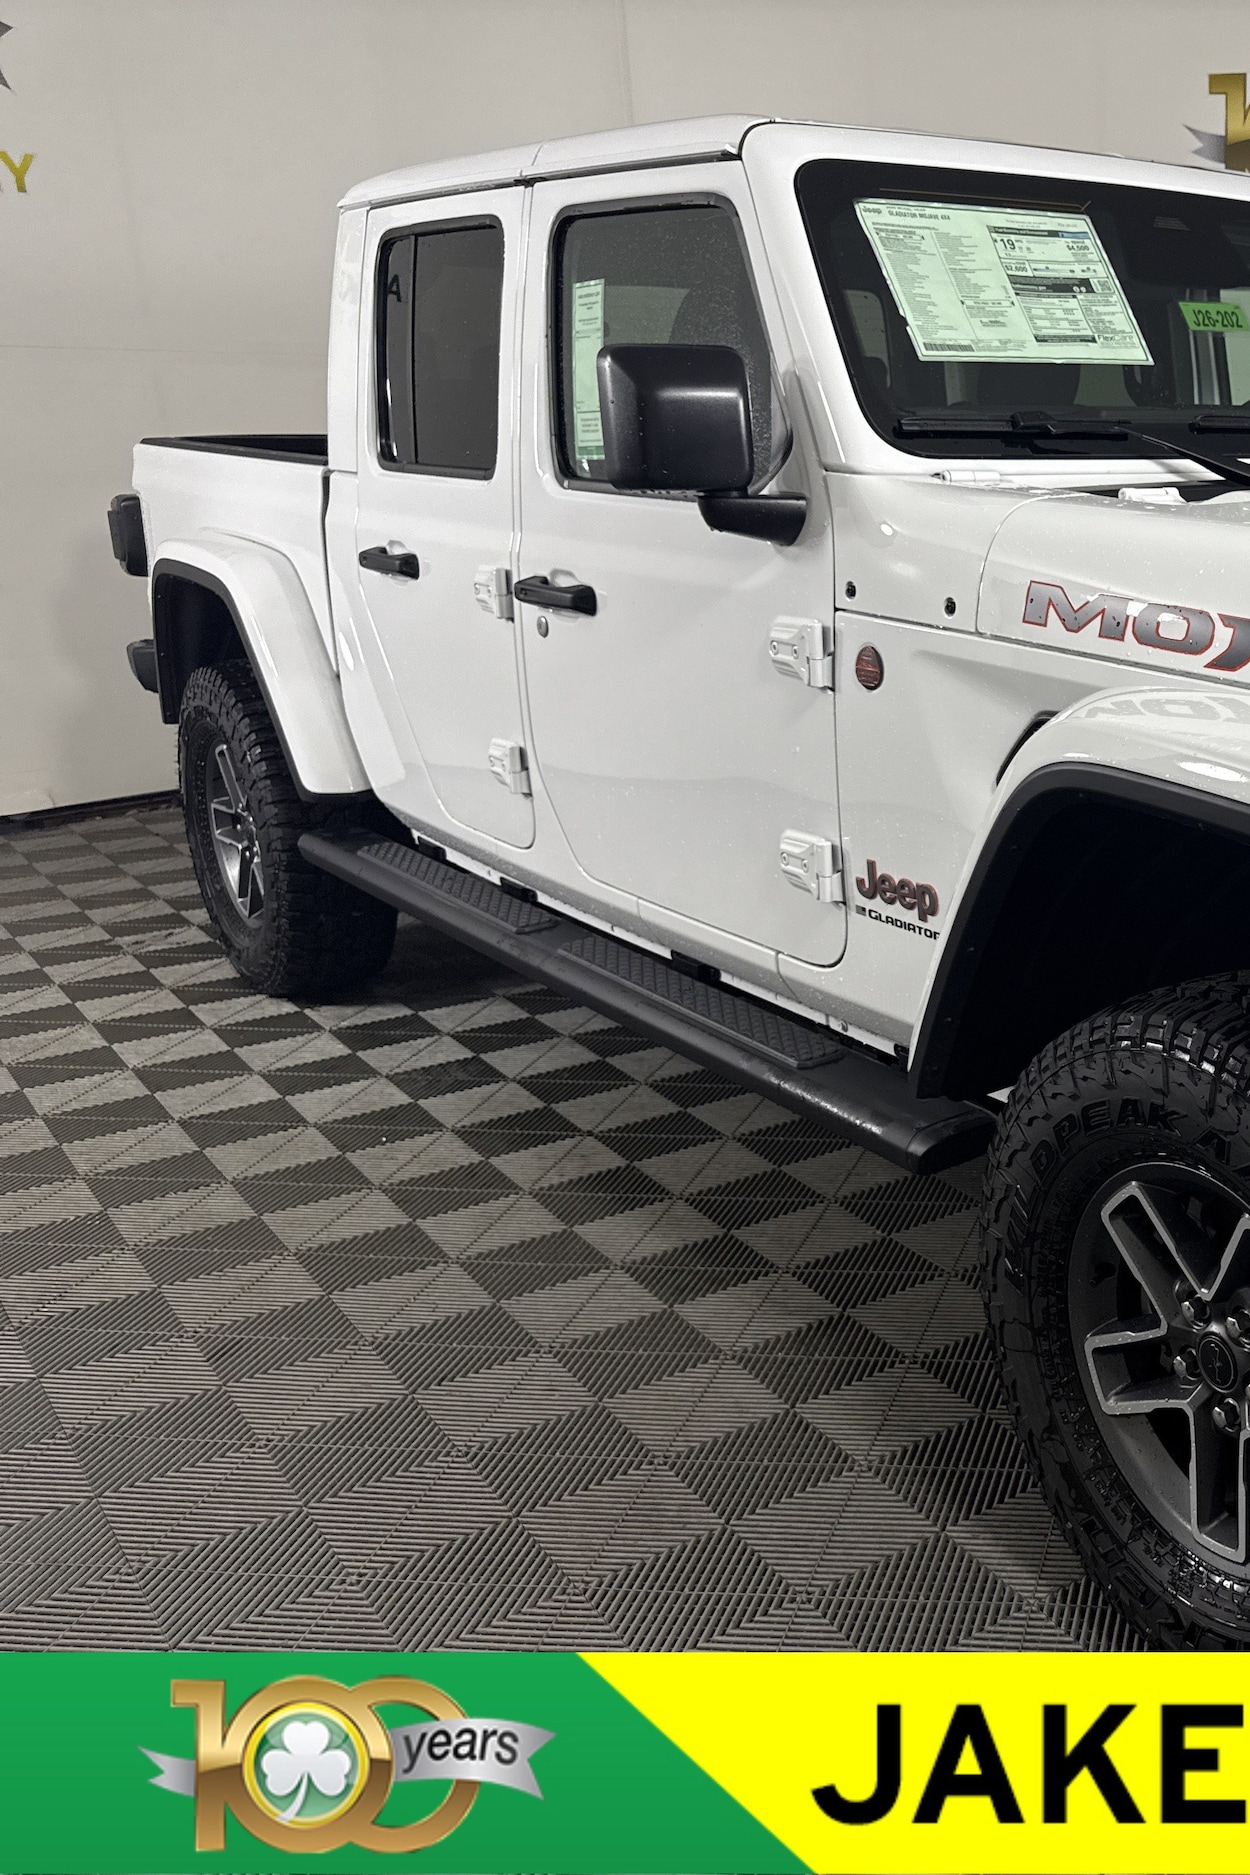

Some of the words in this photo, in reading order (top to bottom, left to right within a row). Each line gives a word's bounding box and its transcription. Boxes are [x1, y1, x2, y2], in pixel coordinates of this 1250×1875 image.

[1000, 238, 1017, 251] 19
[1192, 309, 1244, 329] J26-202
[855, 858, 940, 923] Jeep
